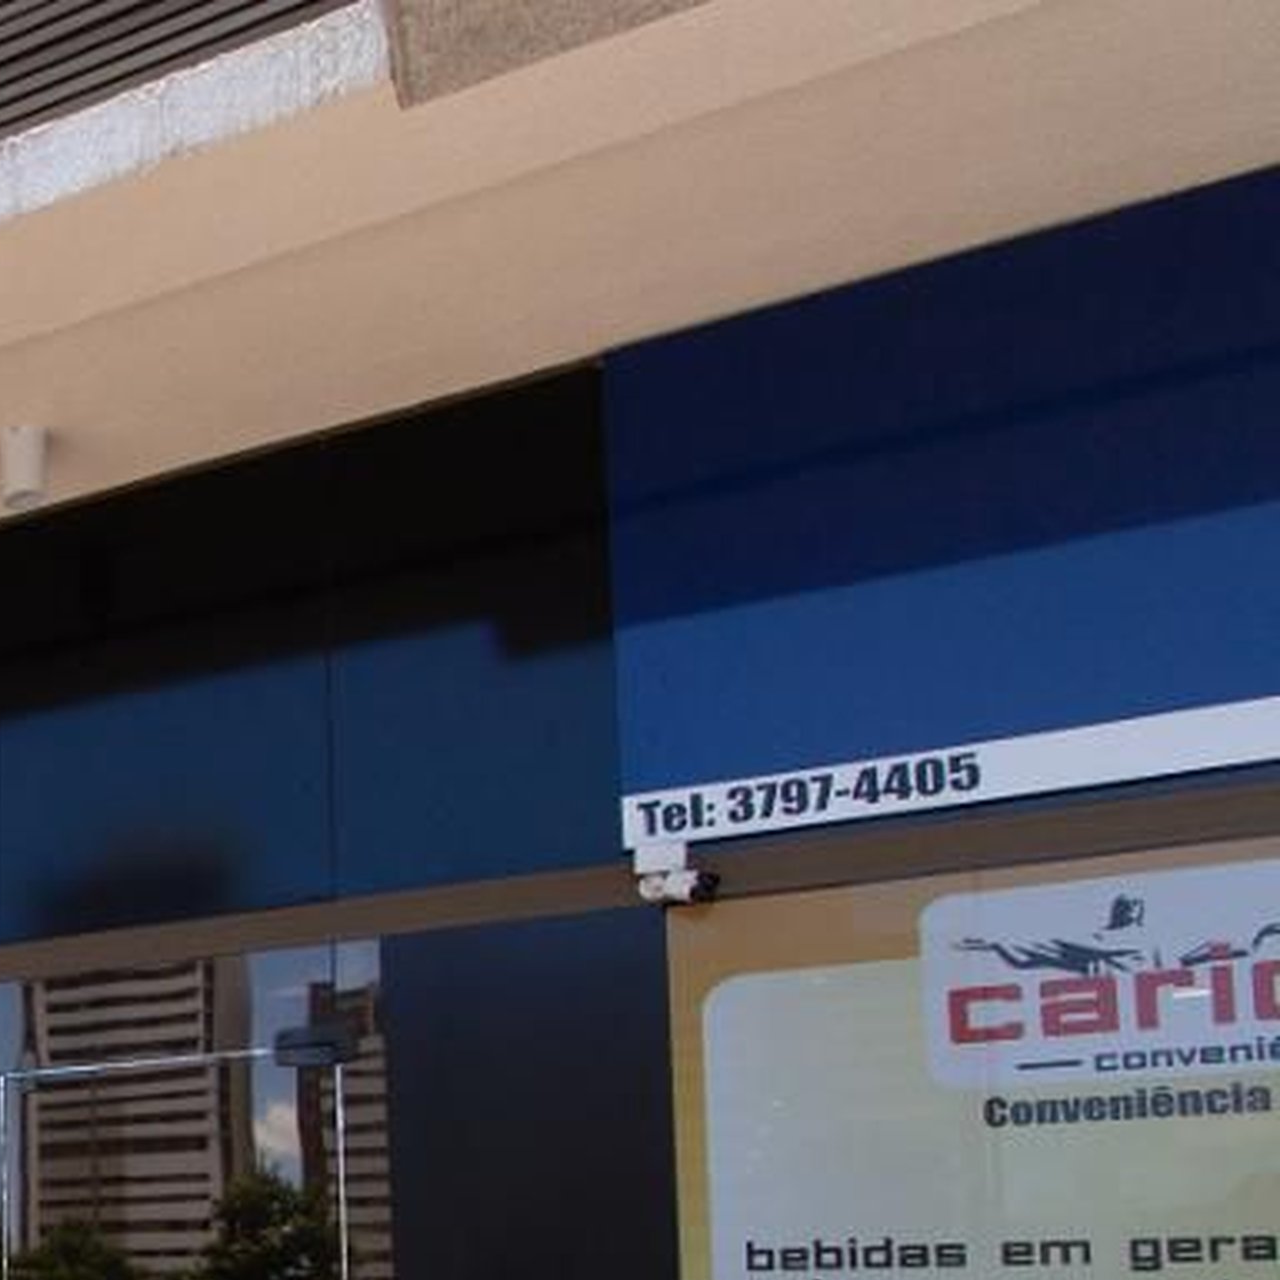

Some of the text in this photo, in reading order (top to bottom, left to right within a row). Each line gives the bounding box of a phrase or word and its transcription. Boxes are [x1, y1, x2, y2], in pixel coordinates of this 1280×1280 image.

[636, 752, 983, 838] Tel: 3797-4405
[982, 1082, 1272, 1129] Conveniência
[745, 1238, 968, 1272] bebidas
[1001, 1236, 1093, 1266] em
